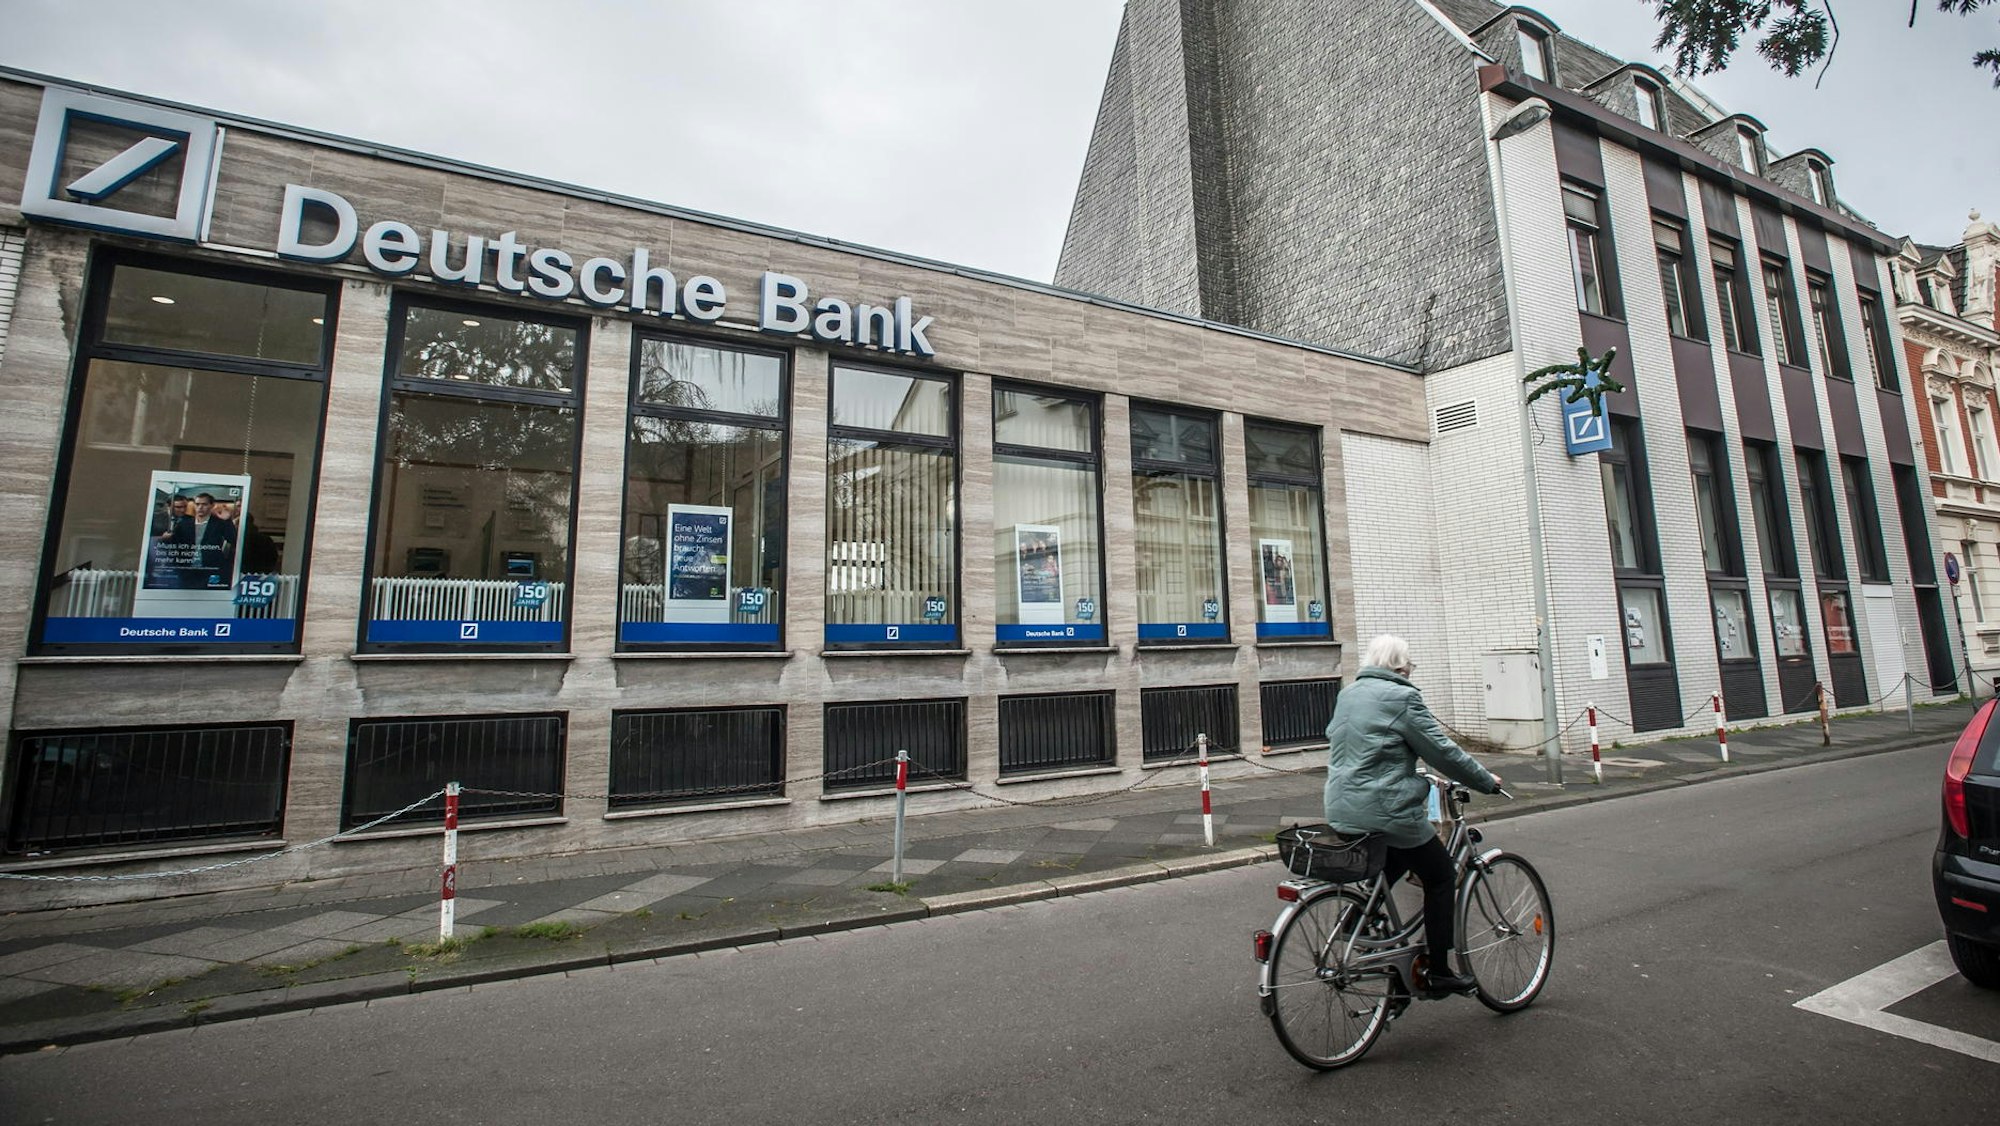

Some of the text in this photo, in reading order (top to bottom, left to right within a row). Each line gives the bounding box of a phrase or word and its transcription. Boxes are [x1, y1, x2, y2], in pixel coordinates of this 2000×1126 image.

[276, 183, 935, 357] Deutsche Bank
[674, 523, 712, 534] Eine Welt
[674, 534, 723, 545] ohne Zinsen
[673, 543, 705, 553] braucht
[239, 581, 275, 596] 150
[518, 585, 546, 598] 150
[741, 592, 764, 605] 150
[926, 601, 945, 612] 150
[1077, 602, 1094, 612] 150
[1204, 602, 1218, 612] 150
[1309, 603, 1322, 612] 150
[120, 627, 208, 637] Deutsche Bank
